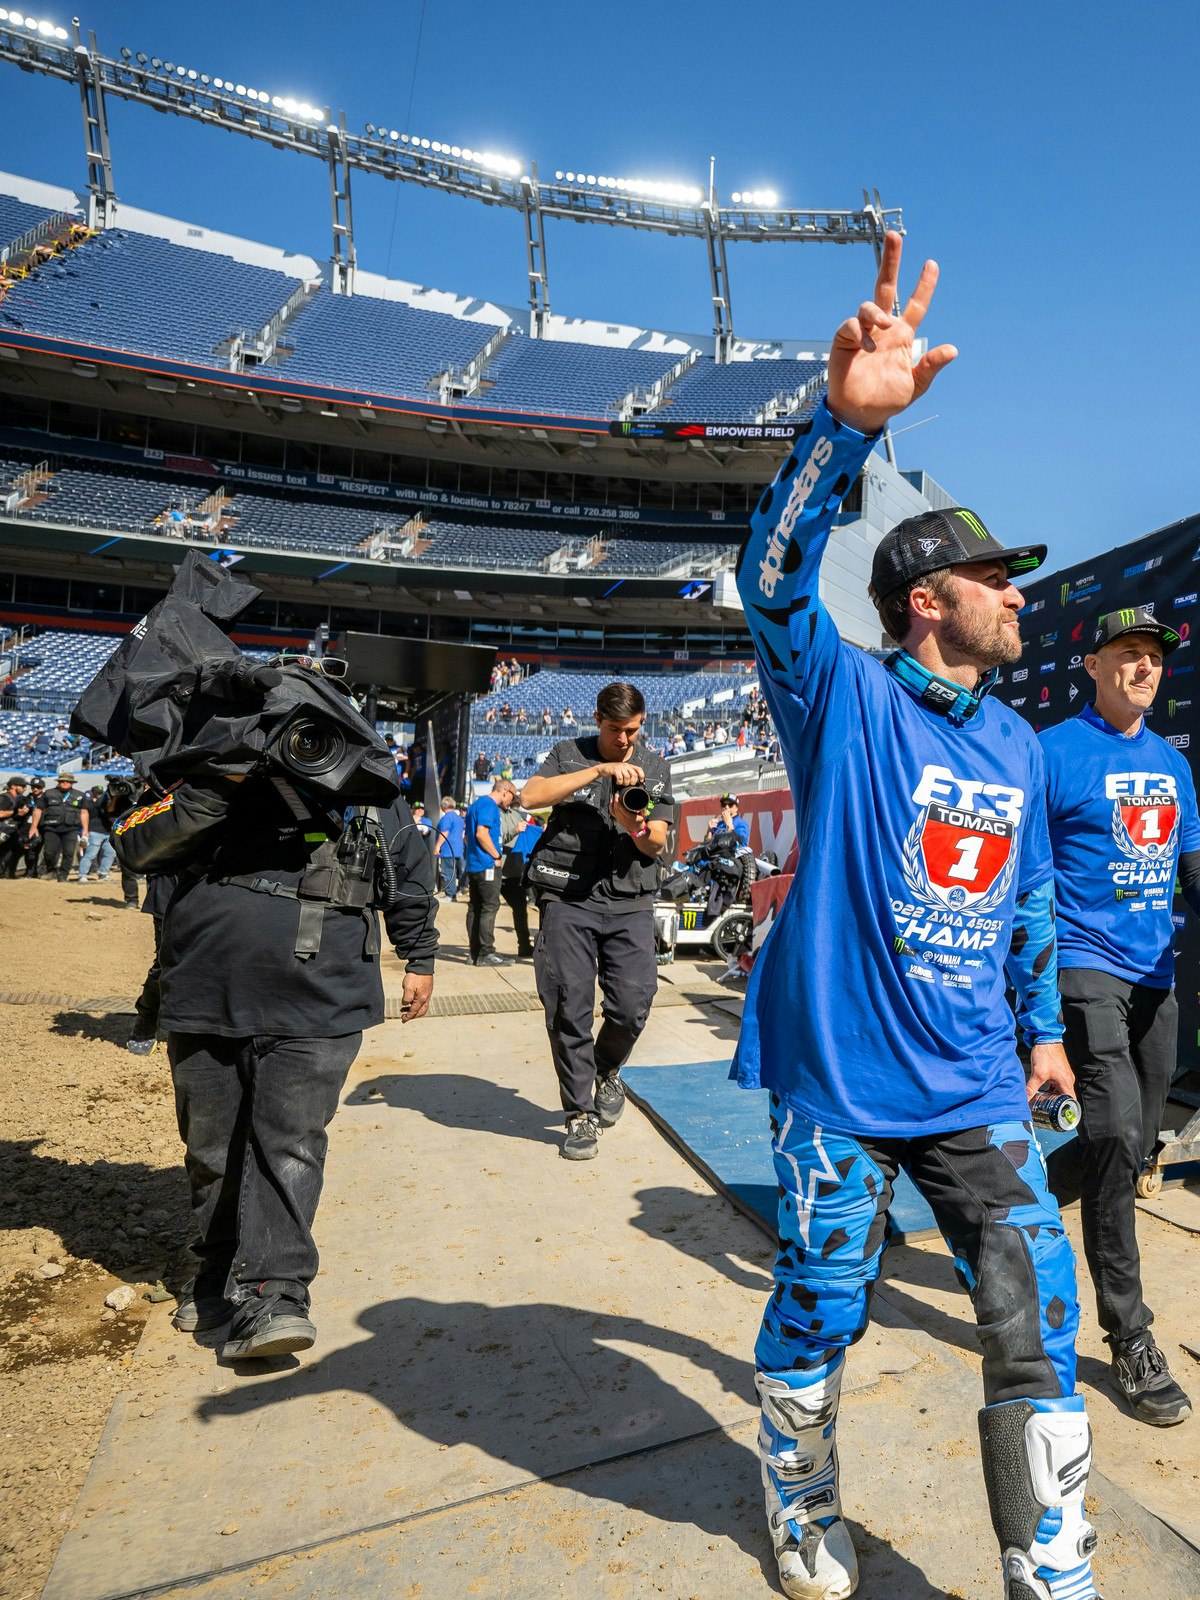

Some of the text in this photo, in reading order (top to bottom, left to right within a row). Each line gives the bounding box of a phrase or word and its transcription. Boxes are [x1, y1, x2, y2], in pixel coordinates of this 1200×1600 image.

[706, 427, 795, 437] EMPOWER FIELD
[224, 465, 245, 477] Fan
[248, 468, 283, 482] issues
[286, 475, 307, 485] text
[395, 489, 417, 499] with
[420, 490, 438, 501] info
[441, 493, 448, 503] &
[451, 494, 488, 508] location
[491, 500, 500, 509] to
[503, 501, 530, 511] 78247
[552, 506, 562, 514] or
[564, 506, 580, 515] call
[759, 436, 833, 598] alpinestars
[1174, 593, 1198, 604] FALKEN
[928, 682, 958, 701] ET3
[912, 764, 1024, 827] ET3
[1105, 772, 1177, 799] ET3
[1124, 796, 1171, 806] TOMAC
[938, 808, 1006, 836] TOMAC
[1140, 809, 1161, 839] 1
[947, 836, 984, 881] 1
[1108, 862, 1137, 870] 2022
[1139, 861, 1160, 870] AMA
[890, 898, 1005, 931] 022 AMA 450SX
[933, 953, 961, 965] YAMAHA
